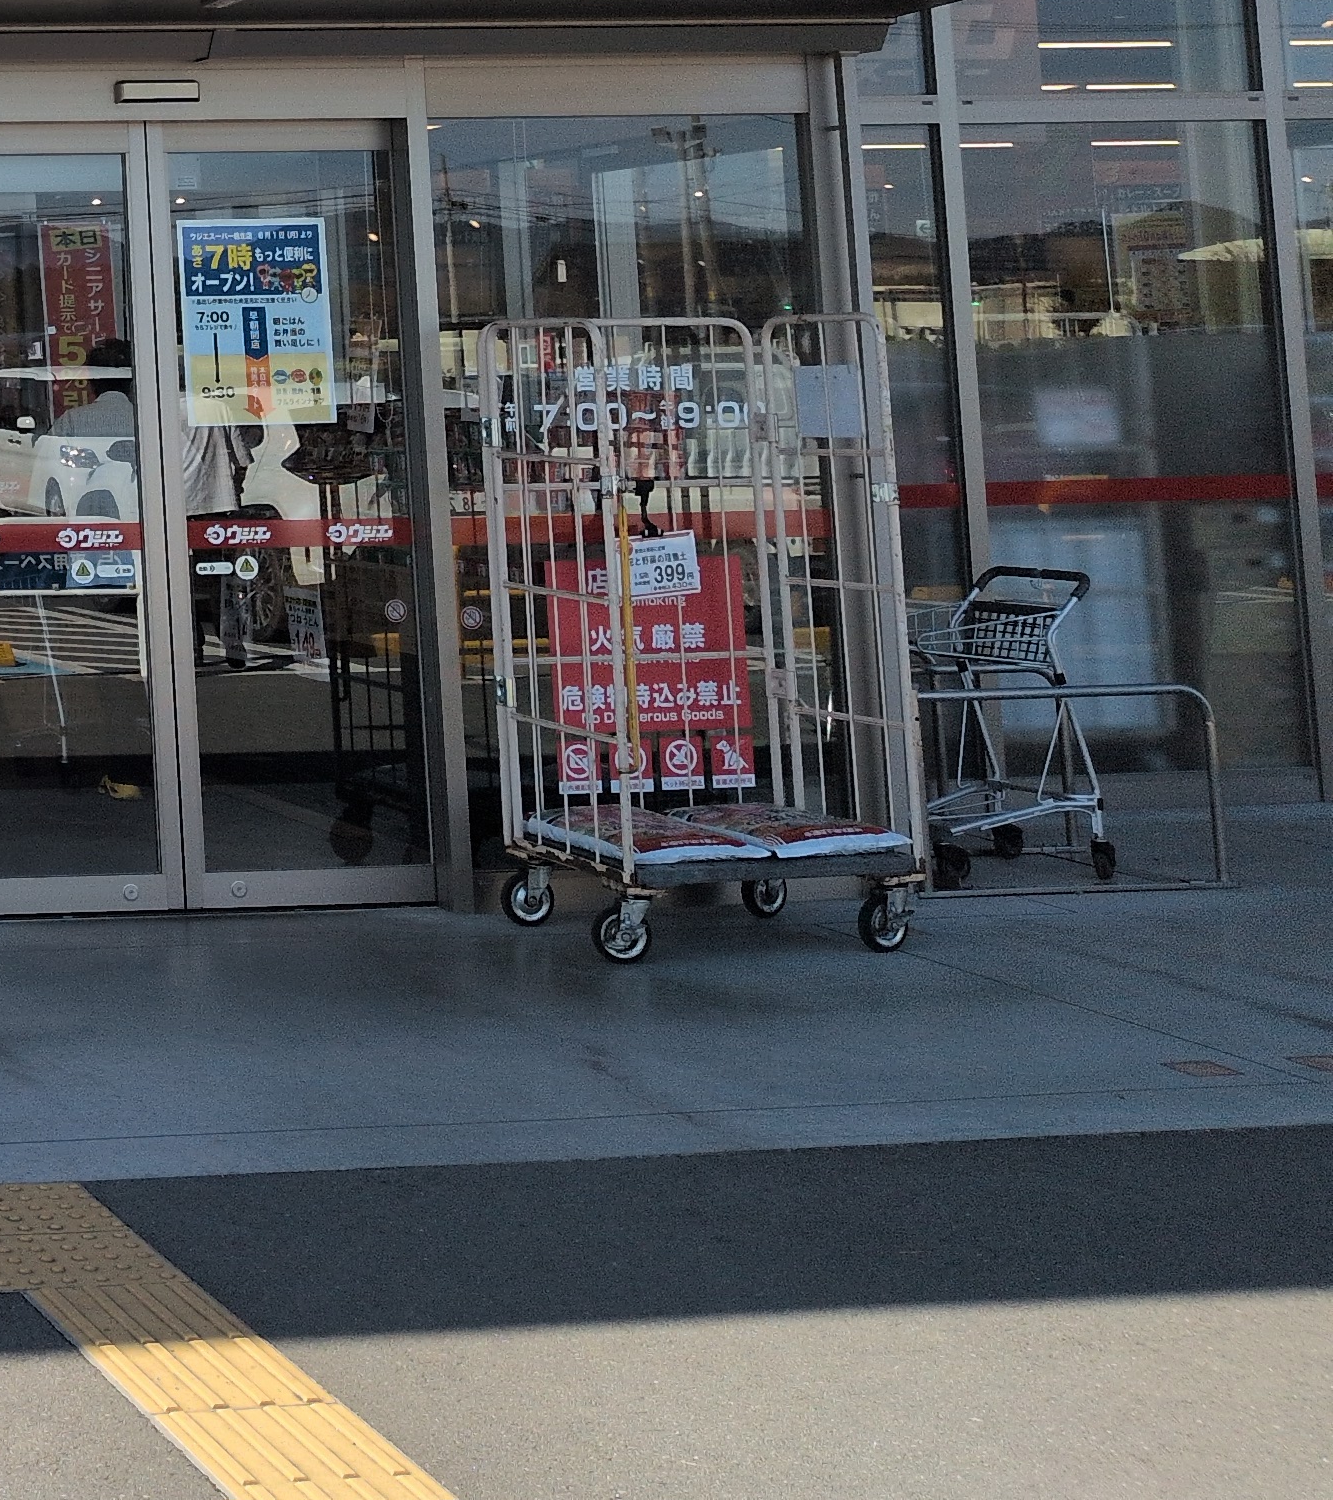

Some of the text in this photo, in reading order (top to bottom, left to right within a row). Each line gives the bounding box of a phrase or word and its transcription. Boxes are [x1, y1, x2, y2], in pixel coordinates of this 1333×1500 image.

[54, 228, 99, 248] 本日
[191, 244, 313, 270] あさ 7時 もっと便利に
[56, 252, 77, 334] カード提示で
[196, 311, 230, 324] 7:00
[574, 363, 694, 392] 営業時間
[287, 613, 319, 627] つねうどん
[681, 709, 724, 721] Goods
